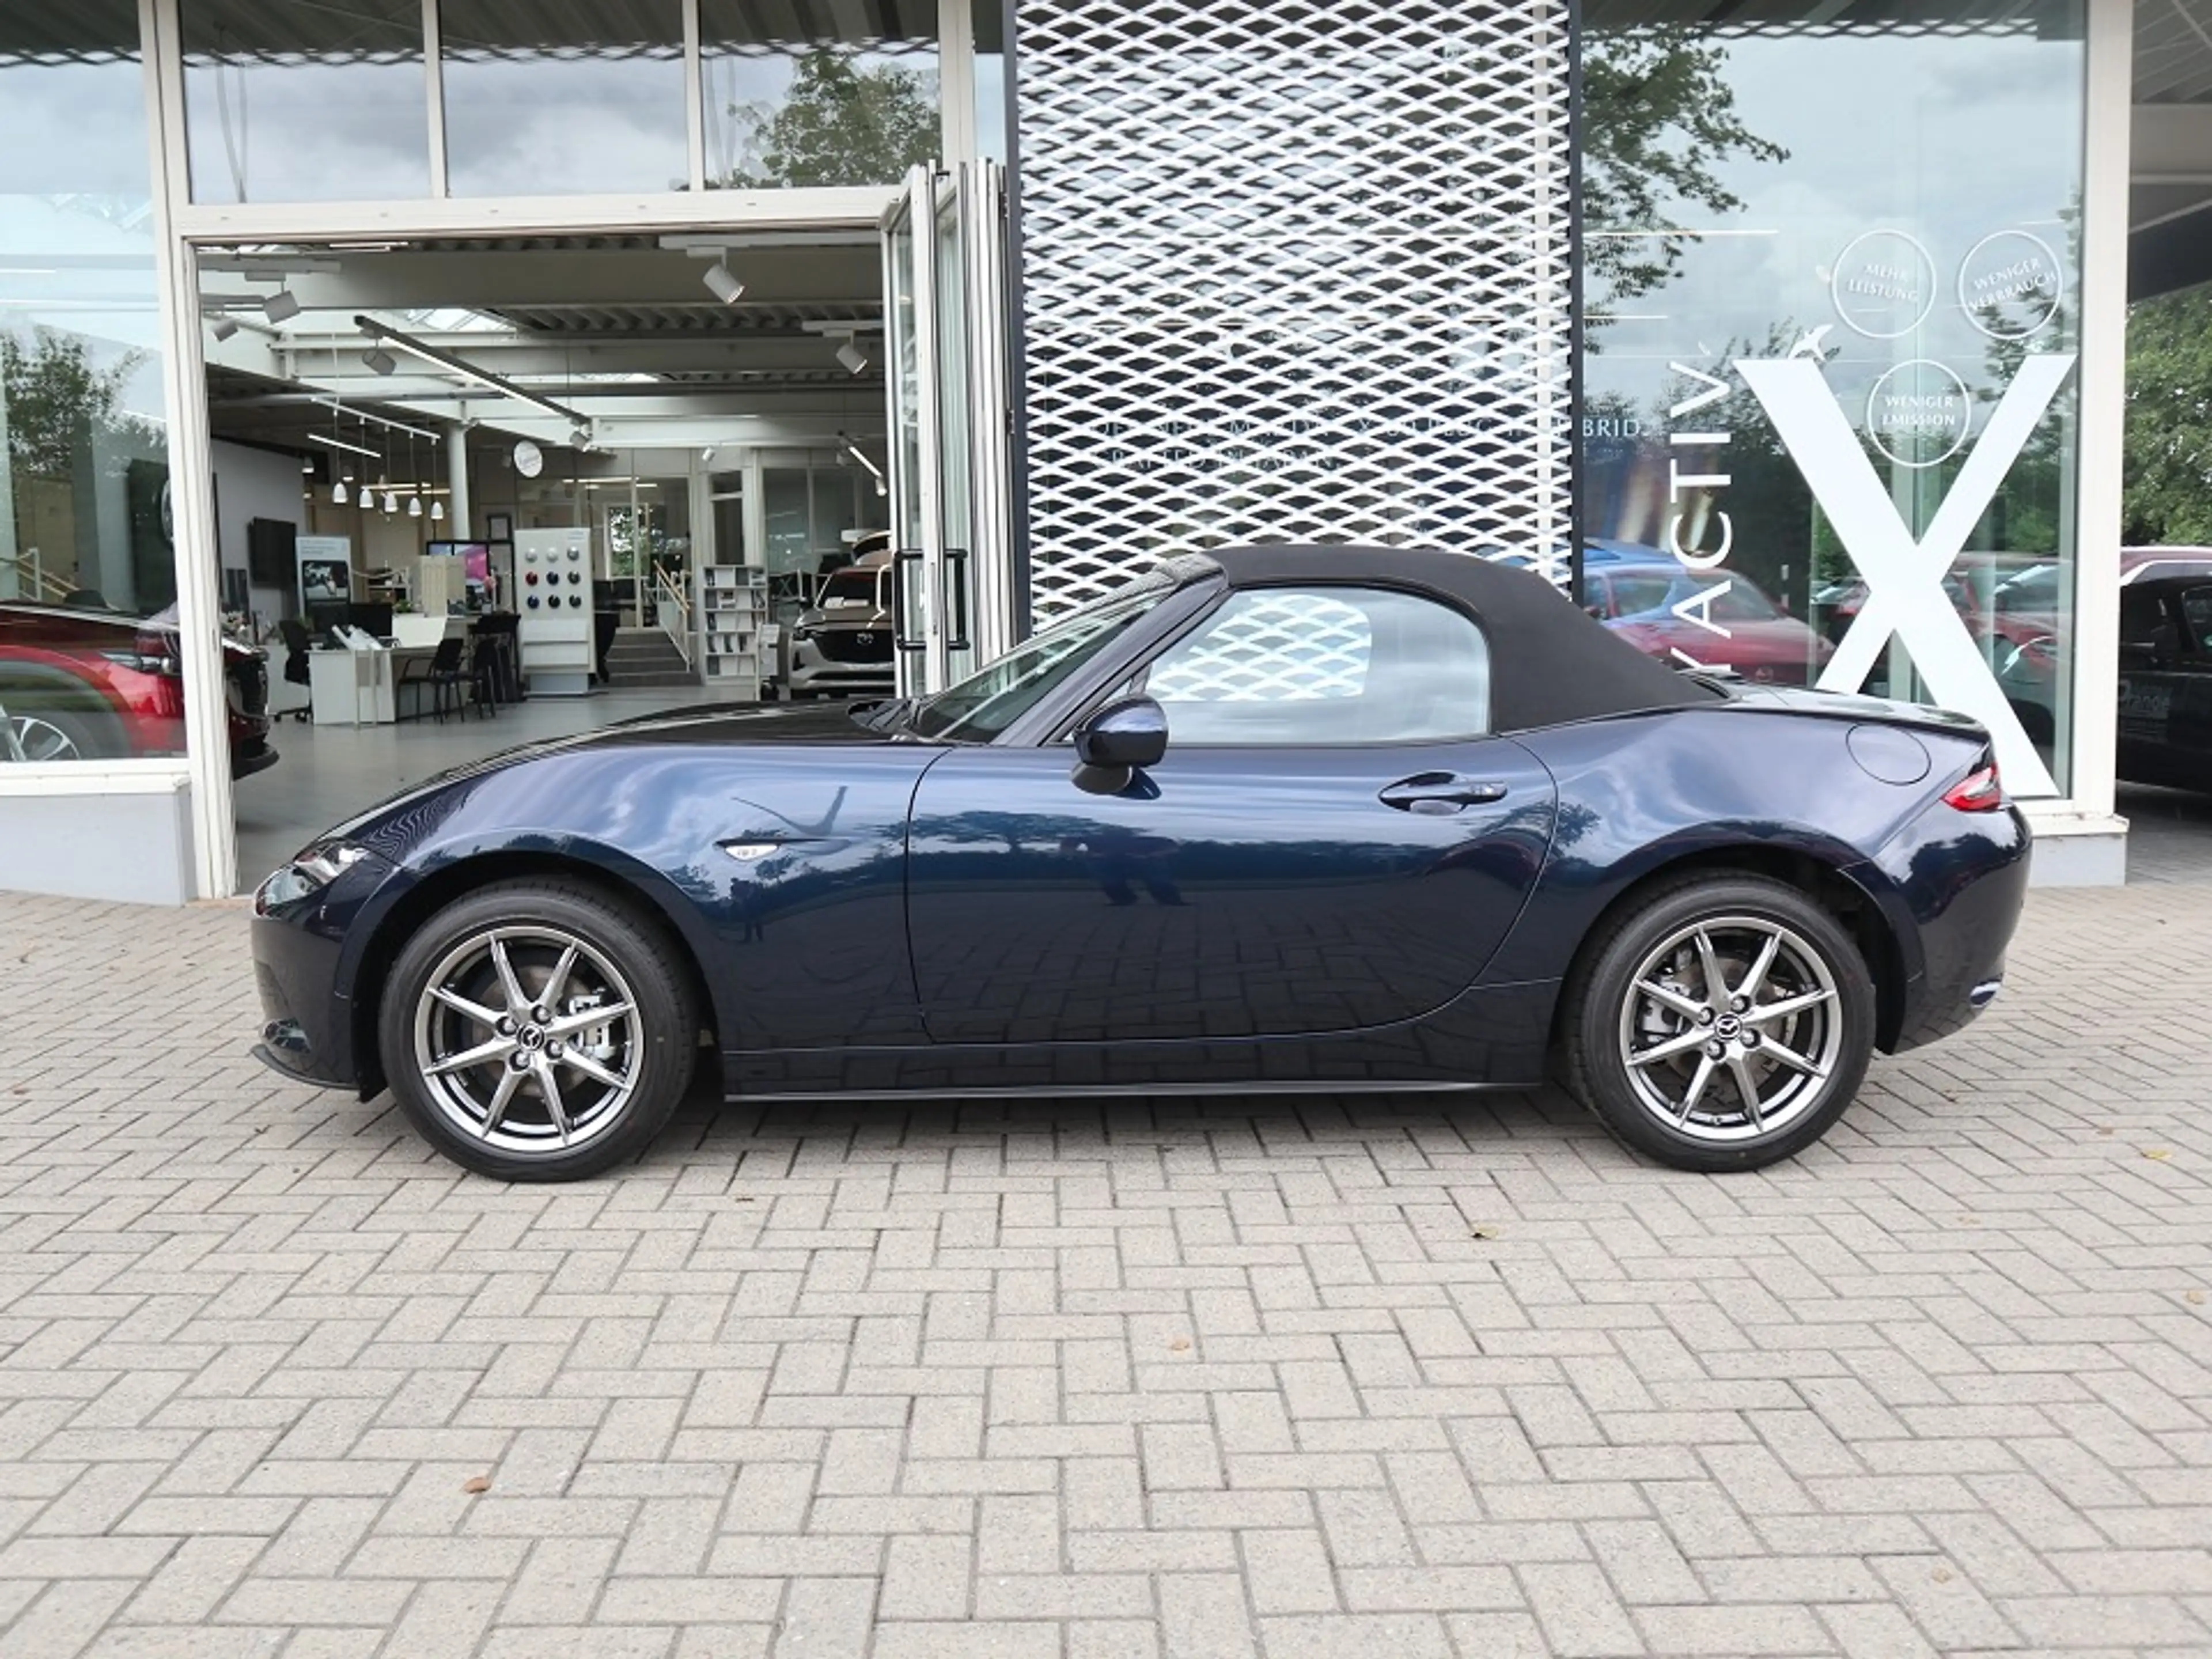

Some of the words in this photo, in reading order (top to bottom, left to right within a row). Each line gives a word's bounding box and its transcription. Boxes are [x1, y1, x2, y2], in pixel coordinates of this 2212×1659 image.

[1863, 263, 1908, 282] MEHR
[1974, 257, 2042, 291] WENIGER
[1847, 278, 1918, 302] LEISTUNG
[1968, 270, 2057, 311] VERBRAUCH
[1884, 396, 1953, 408] WENIGER
[1882, 414, 1955, 426] EMISSION
